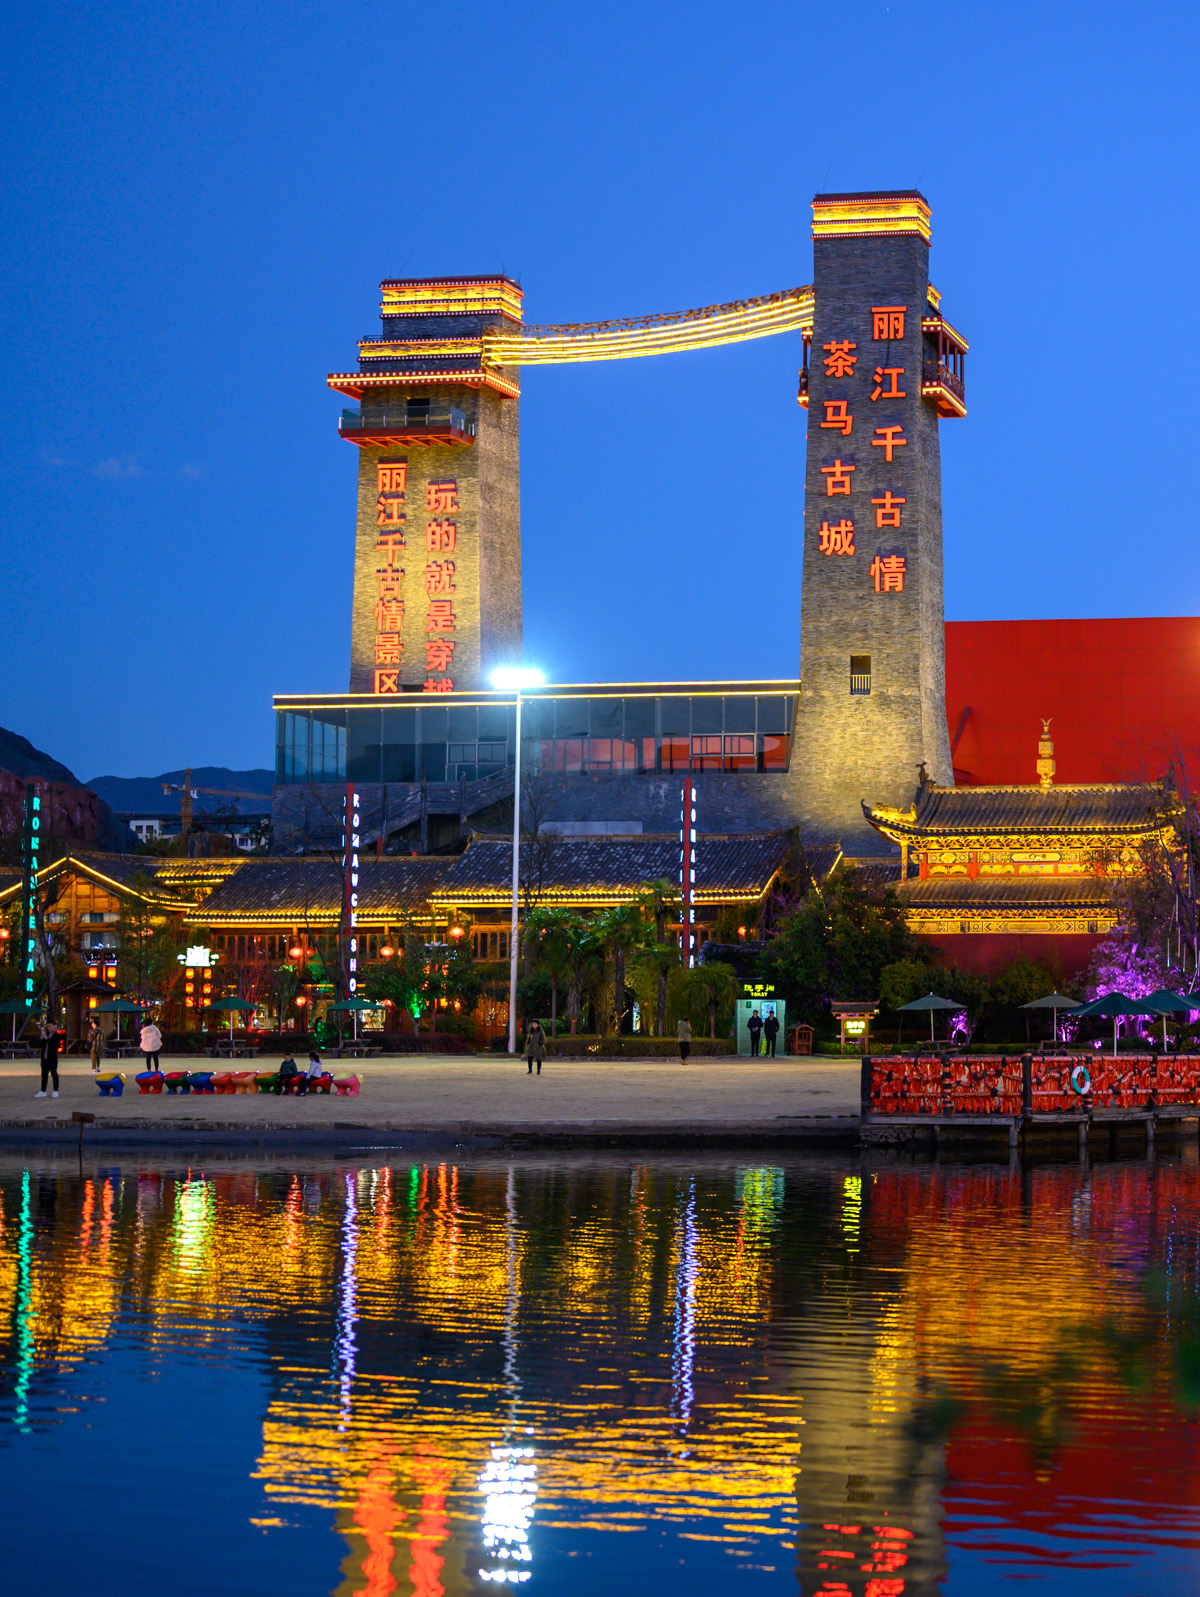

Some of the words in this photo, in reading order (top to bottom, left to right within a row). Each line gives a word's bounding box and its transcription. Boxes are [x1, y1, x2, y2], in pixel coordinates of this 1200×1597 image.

[818, 339, 858, 556] 茶马古城
[870, 305, 907, 593] 丽江千古情
[373, 462, 408, 694] 丽江千古情景区
[28, 796, 41, 930] ROMANCE
[350, 793, 360, 928] ROMANCE
[349, 938, 358, 996] SHO
